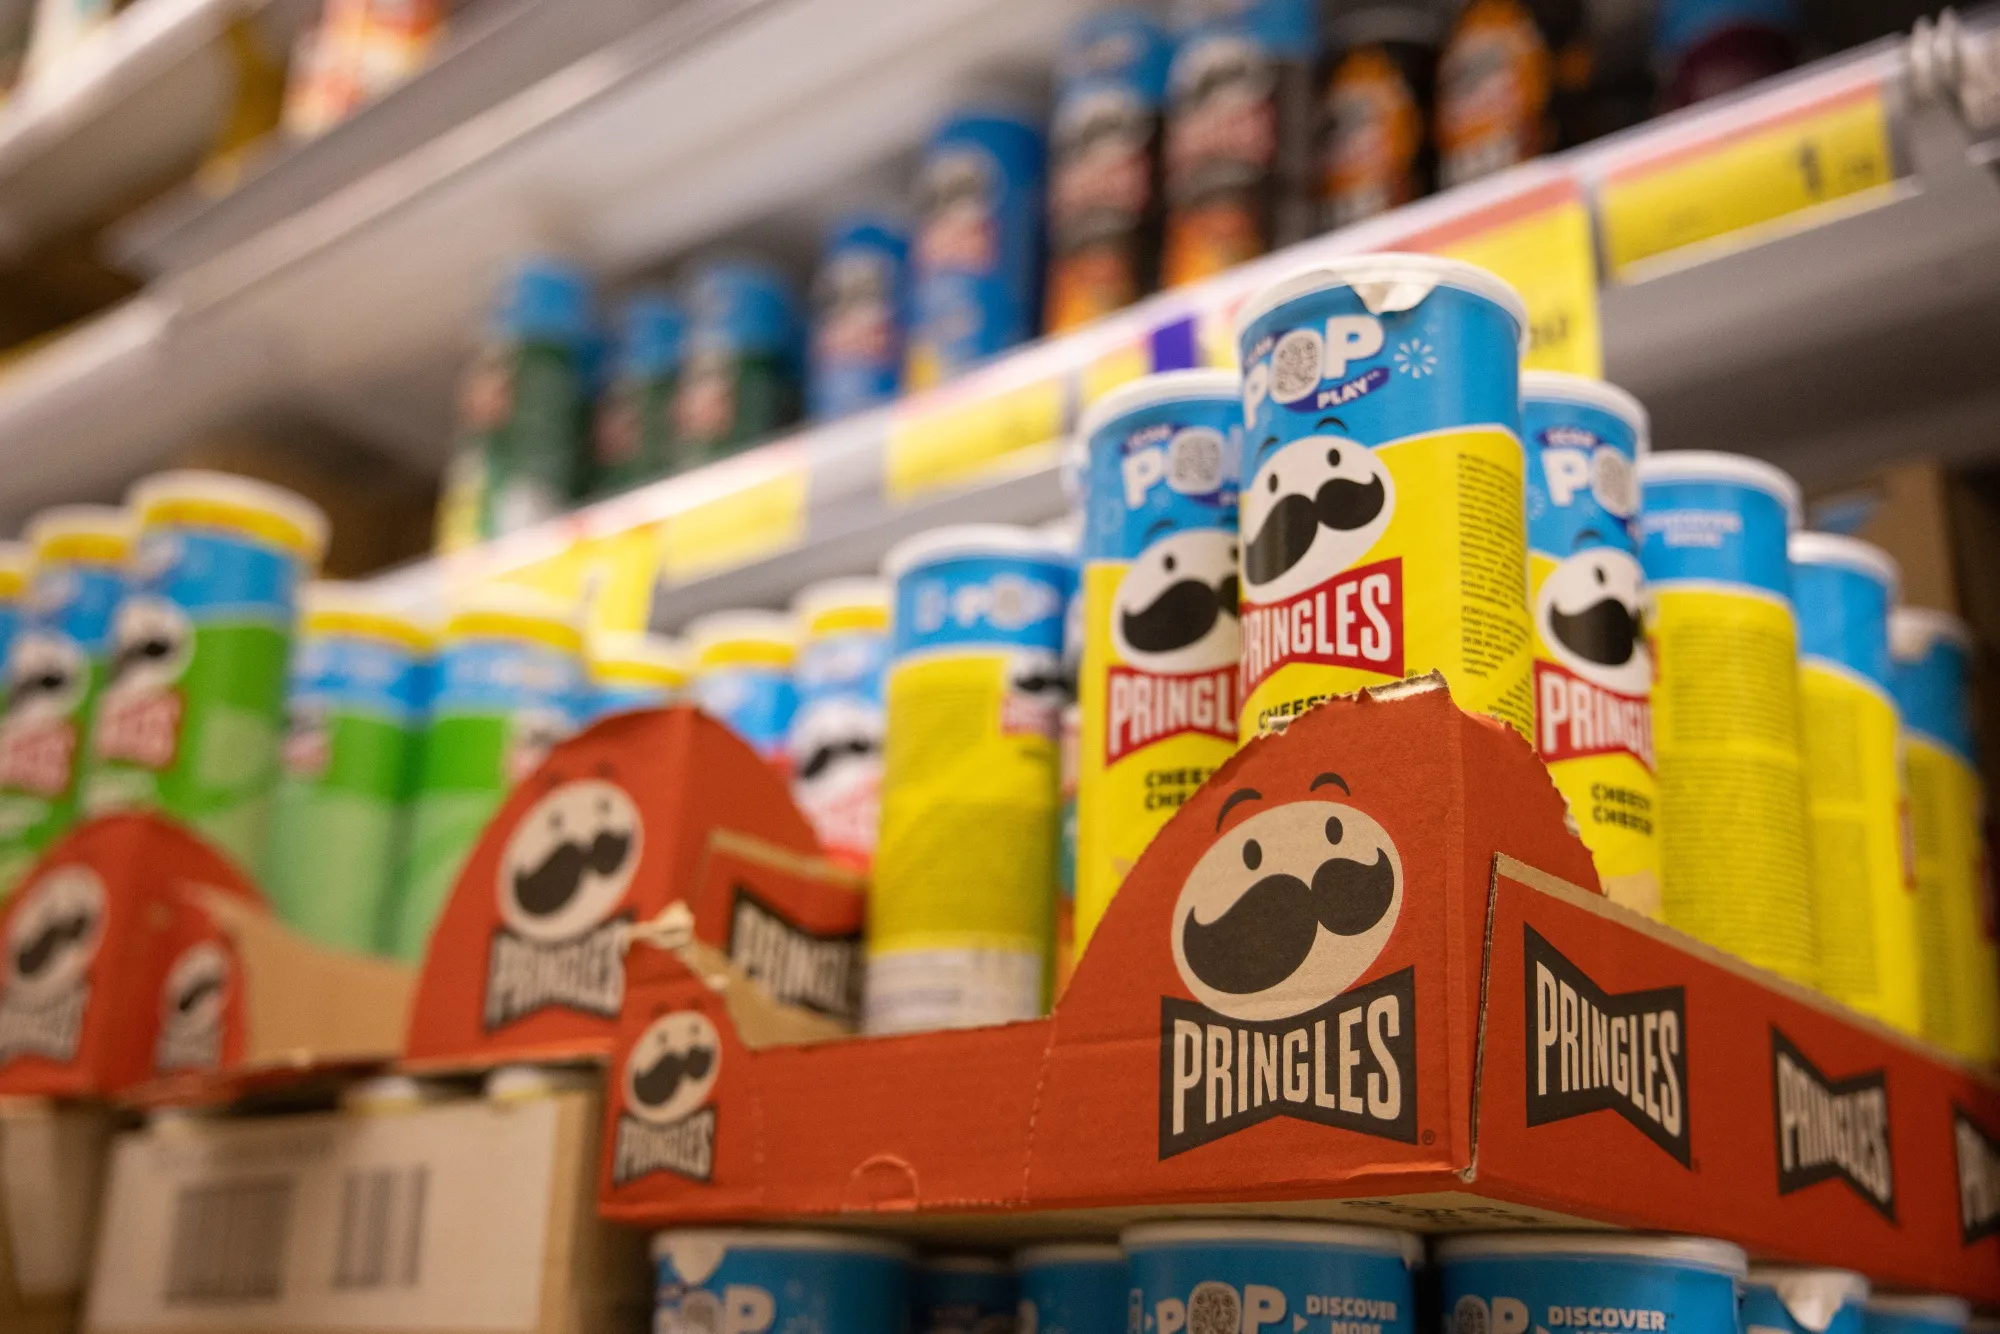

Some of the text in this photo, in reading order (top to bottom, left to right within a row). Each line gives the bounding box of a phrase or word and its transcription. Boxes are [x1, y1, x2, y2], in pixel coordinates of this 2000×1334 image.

[1316, 377, 1368, 410] PLAY
[1172, 994, 1402, 1136] PRINGLES
[1536, 960, 1683, 1138] PRINGLES
[1305, 1294, 1397, 1321] DISCOVER
[1547, 1305, 1666, 1331] DISCOVER
